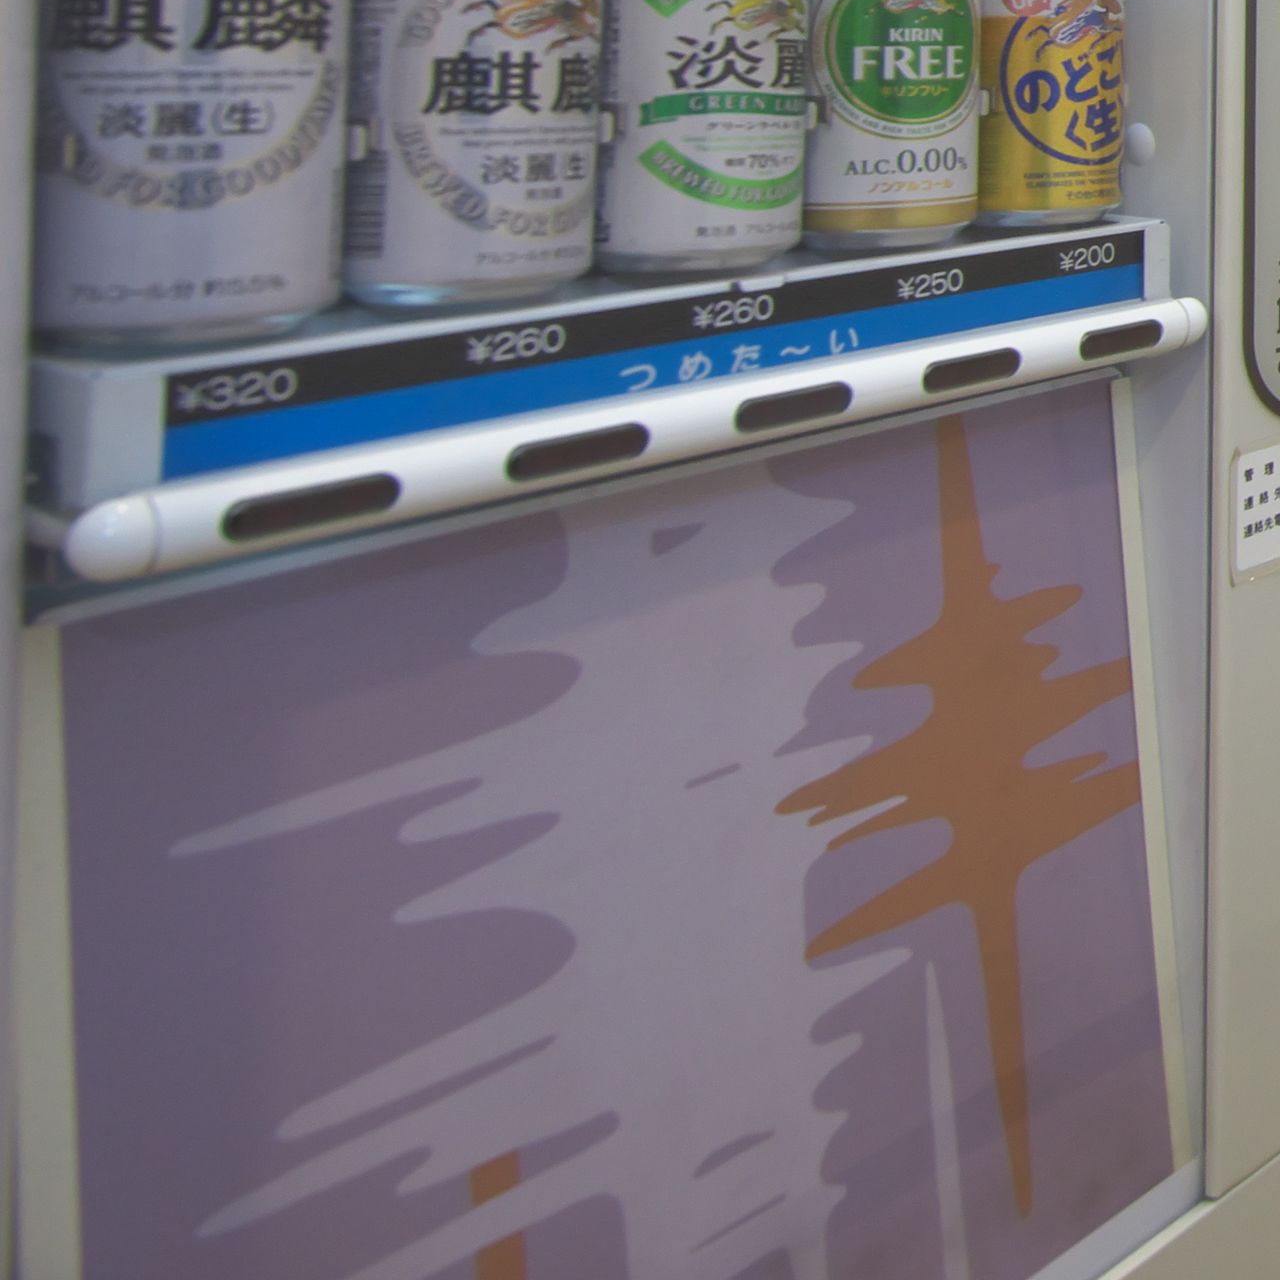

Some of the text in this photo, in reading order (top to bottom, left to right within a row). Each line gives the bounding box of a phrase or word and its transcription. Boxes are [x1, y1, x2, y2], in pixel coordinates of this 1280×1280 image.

[889, 27, 944, 42] KIRIN
[852, 45, 965, 81] FREE
[688, 95, 766, 112] GREEN
[880, 84, 951, 97] キリンフリー
[867, 179, 954, 195] ノンアルコール
[1059, 241, 1116, 273] ¥200
[897, 269, 964, 300] ¥250
[692, 294, 775, 329] ¥260
[466, 324, 566, 365] ¥260
[176, 367, 298, 412] ¥320
